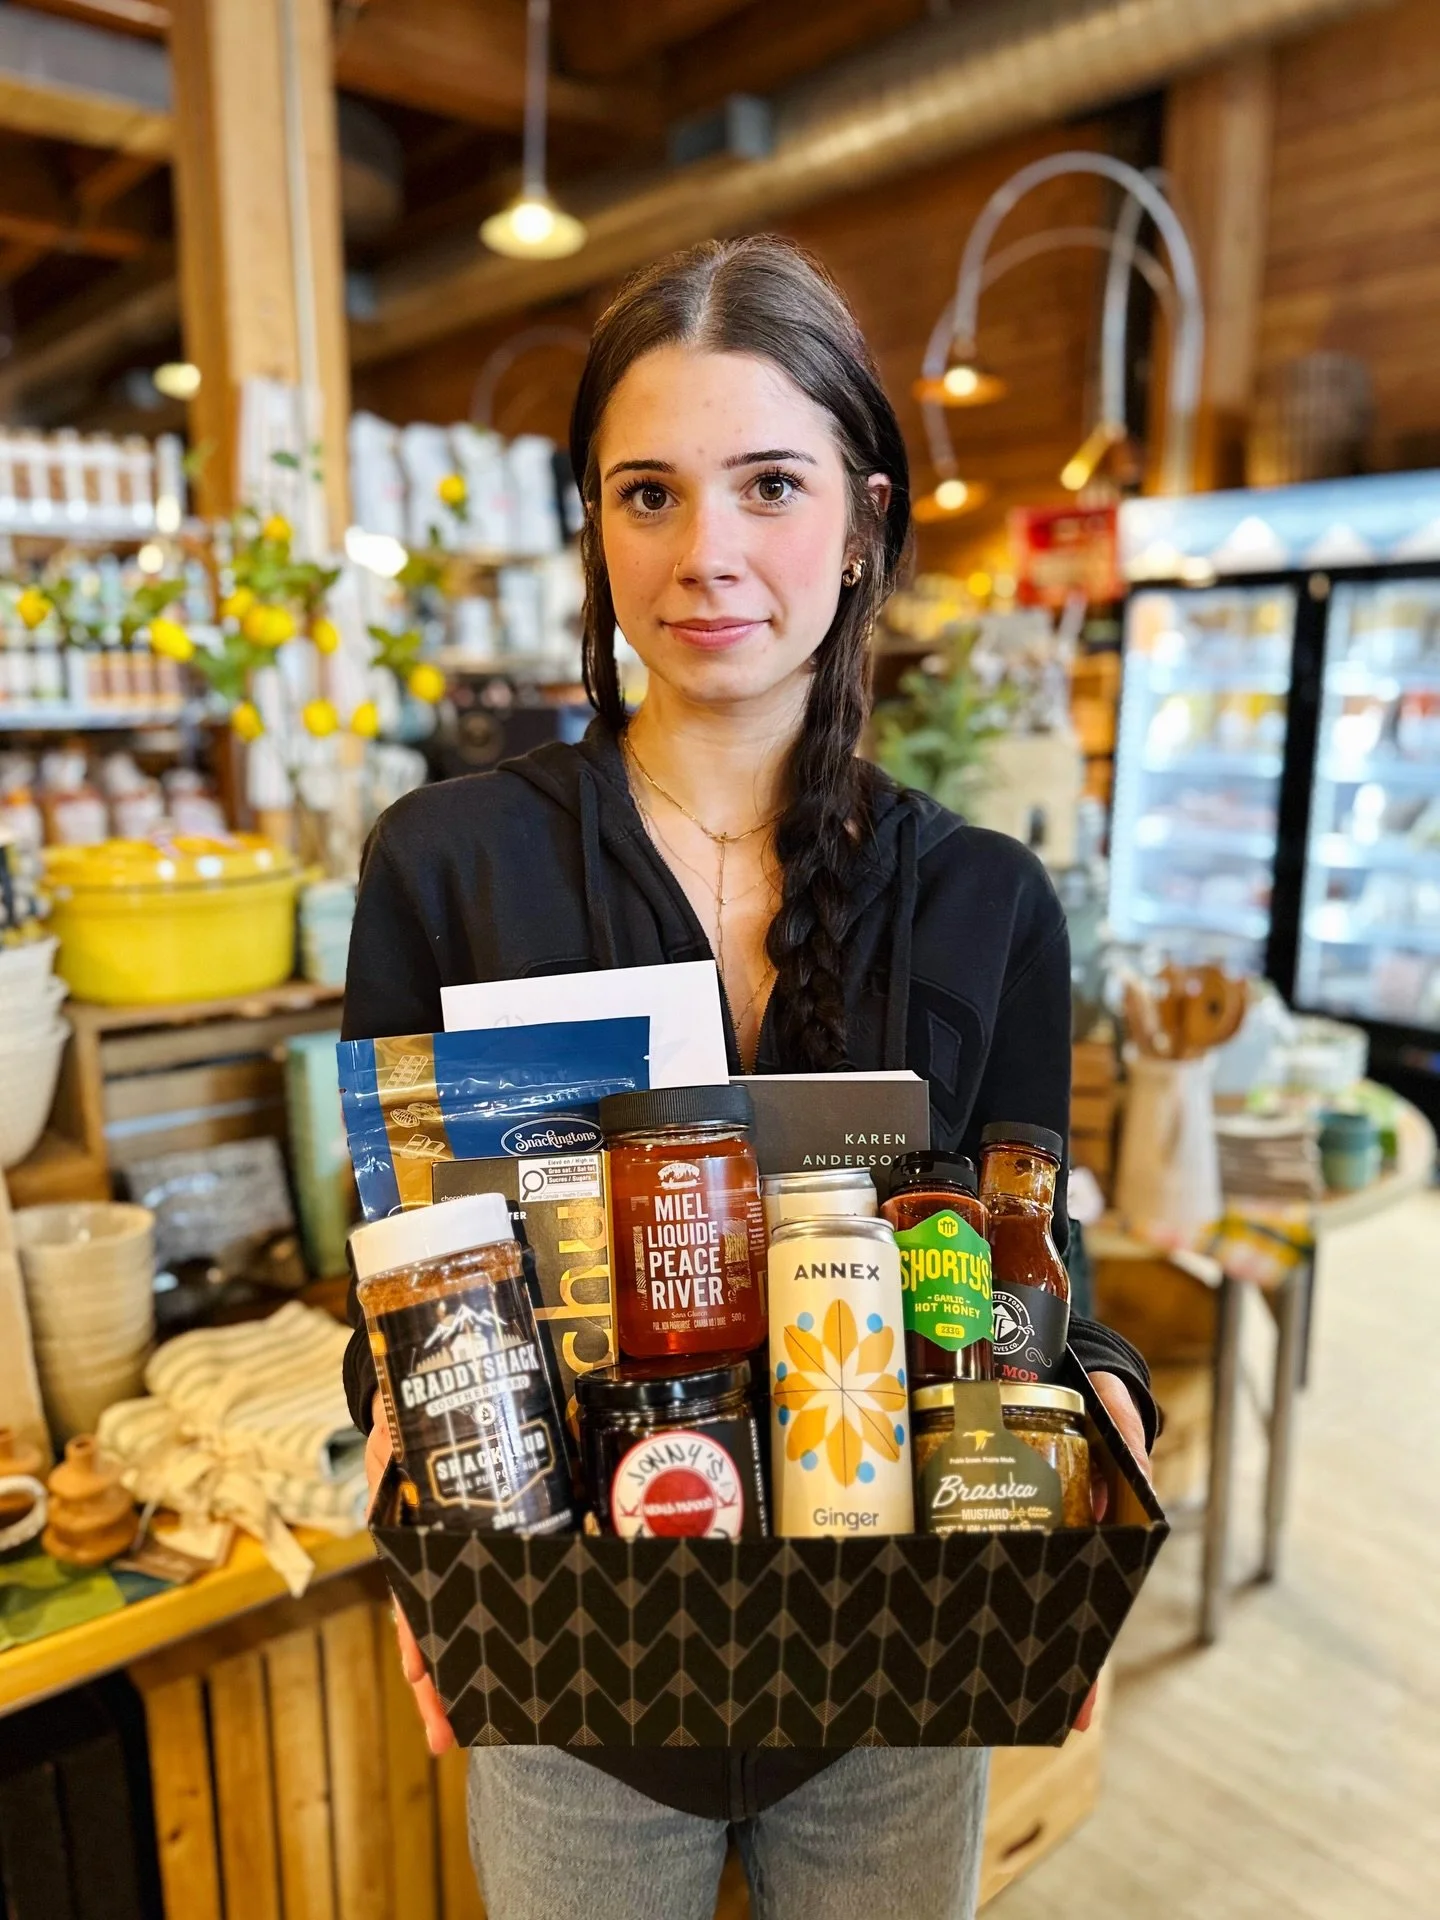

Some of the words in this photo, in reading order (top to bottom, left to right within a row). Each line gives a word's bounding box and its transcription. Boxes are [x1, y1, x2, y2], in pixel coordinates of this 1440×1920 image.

[514, 1129, 597, 1152] Snackingtons
[845, 1133, 906, 1145] KAREN
[802, 1155, 899, 1166] ANDERSO
[655, 1193, 709, 1222] MIEL
[647, 1221, 719, 1249] LIQUIDE
[649, 1246, 722, 1278] PEACE
[793, 1263, 880, 1281] ANNEX
[899, 1248, 990, 1300] SHORTY'S
[651, 1276, 725, 1311] RIVER
[934, 1294, 965, 1305] GARLIC
[1007, 1297, 1024, 1313] FORK
[914, 1302, 938, 1313] HOT
[943, 1303, 981, 1319] HONEY
[941, 1325, 961, 1336] 233G
[1009, 1341, 1020, 1350] CO.
[1002, 1364, 1039, 1384] MOP
[430, 1381, 500, 1416] SOUTHERN
[435, 1445, 502, 1480] SHACK
[627, 1443, 725, 1487] JONNY'S
[932, 1472, 1038, 1509] Brassica
[813, 1507, 879, 1530] Ginger
[961, 1508, 1009, 1520] MUSTARD
